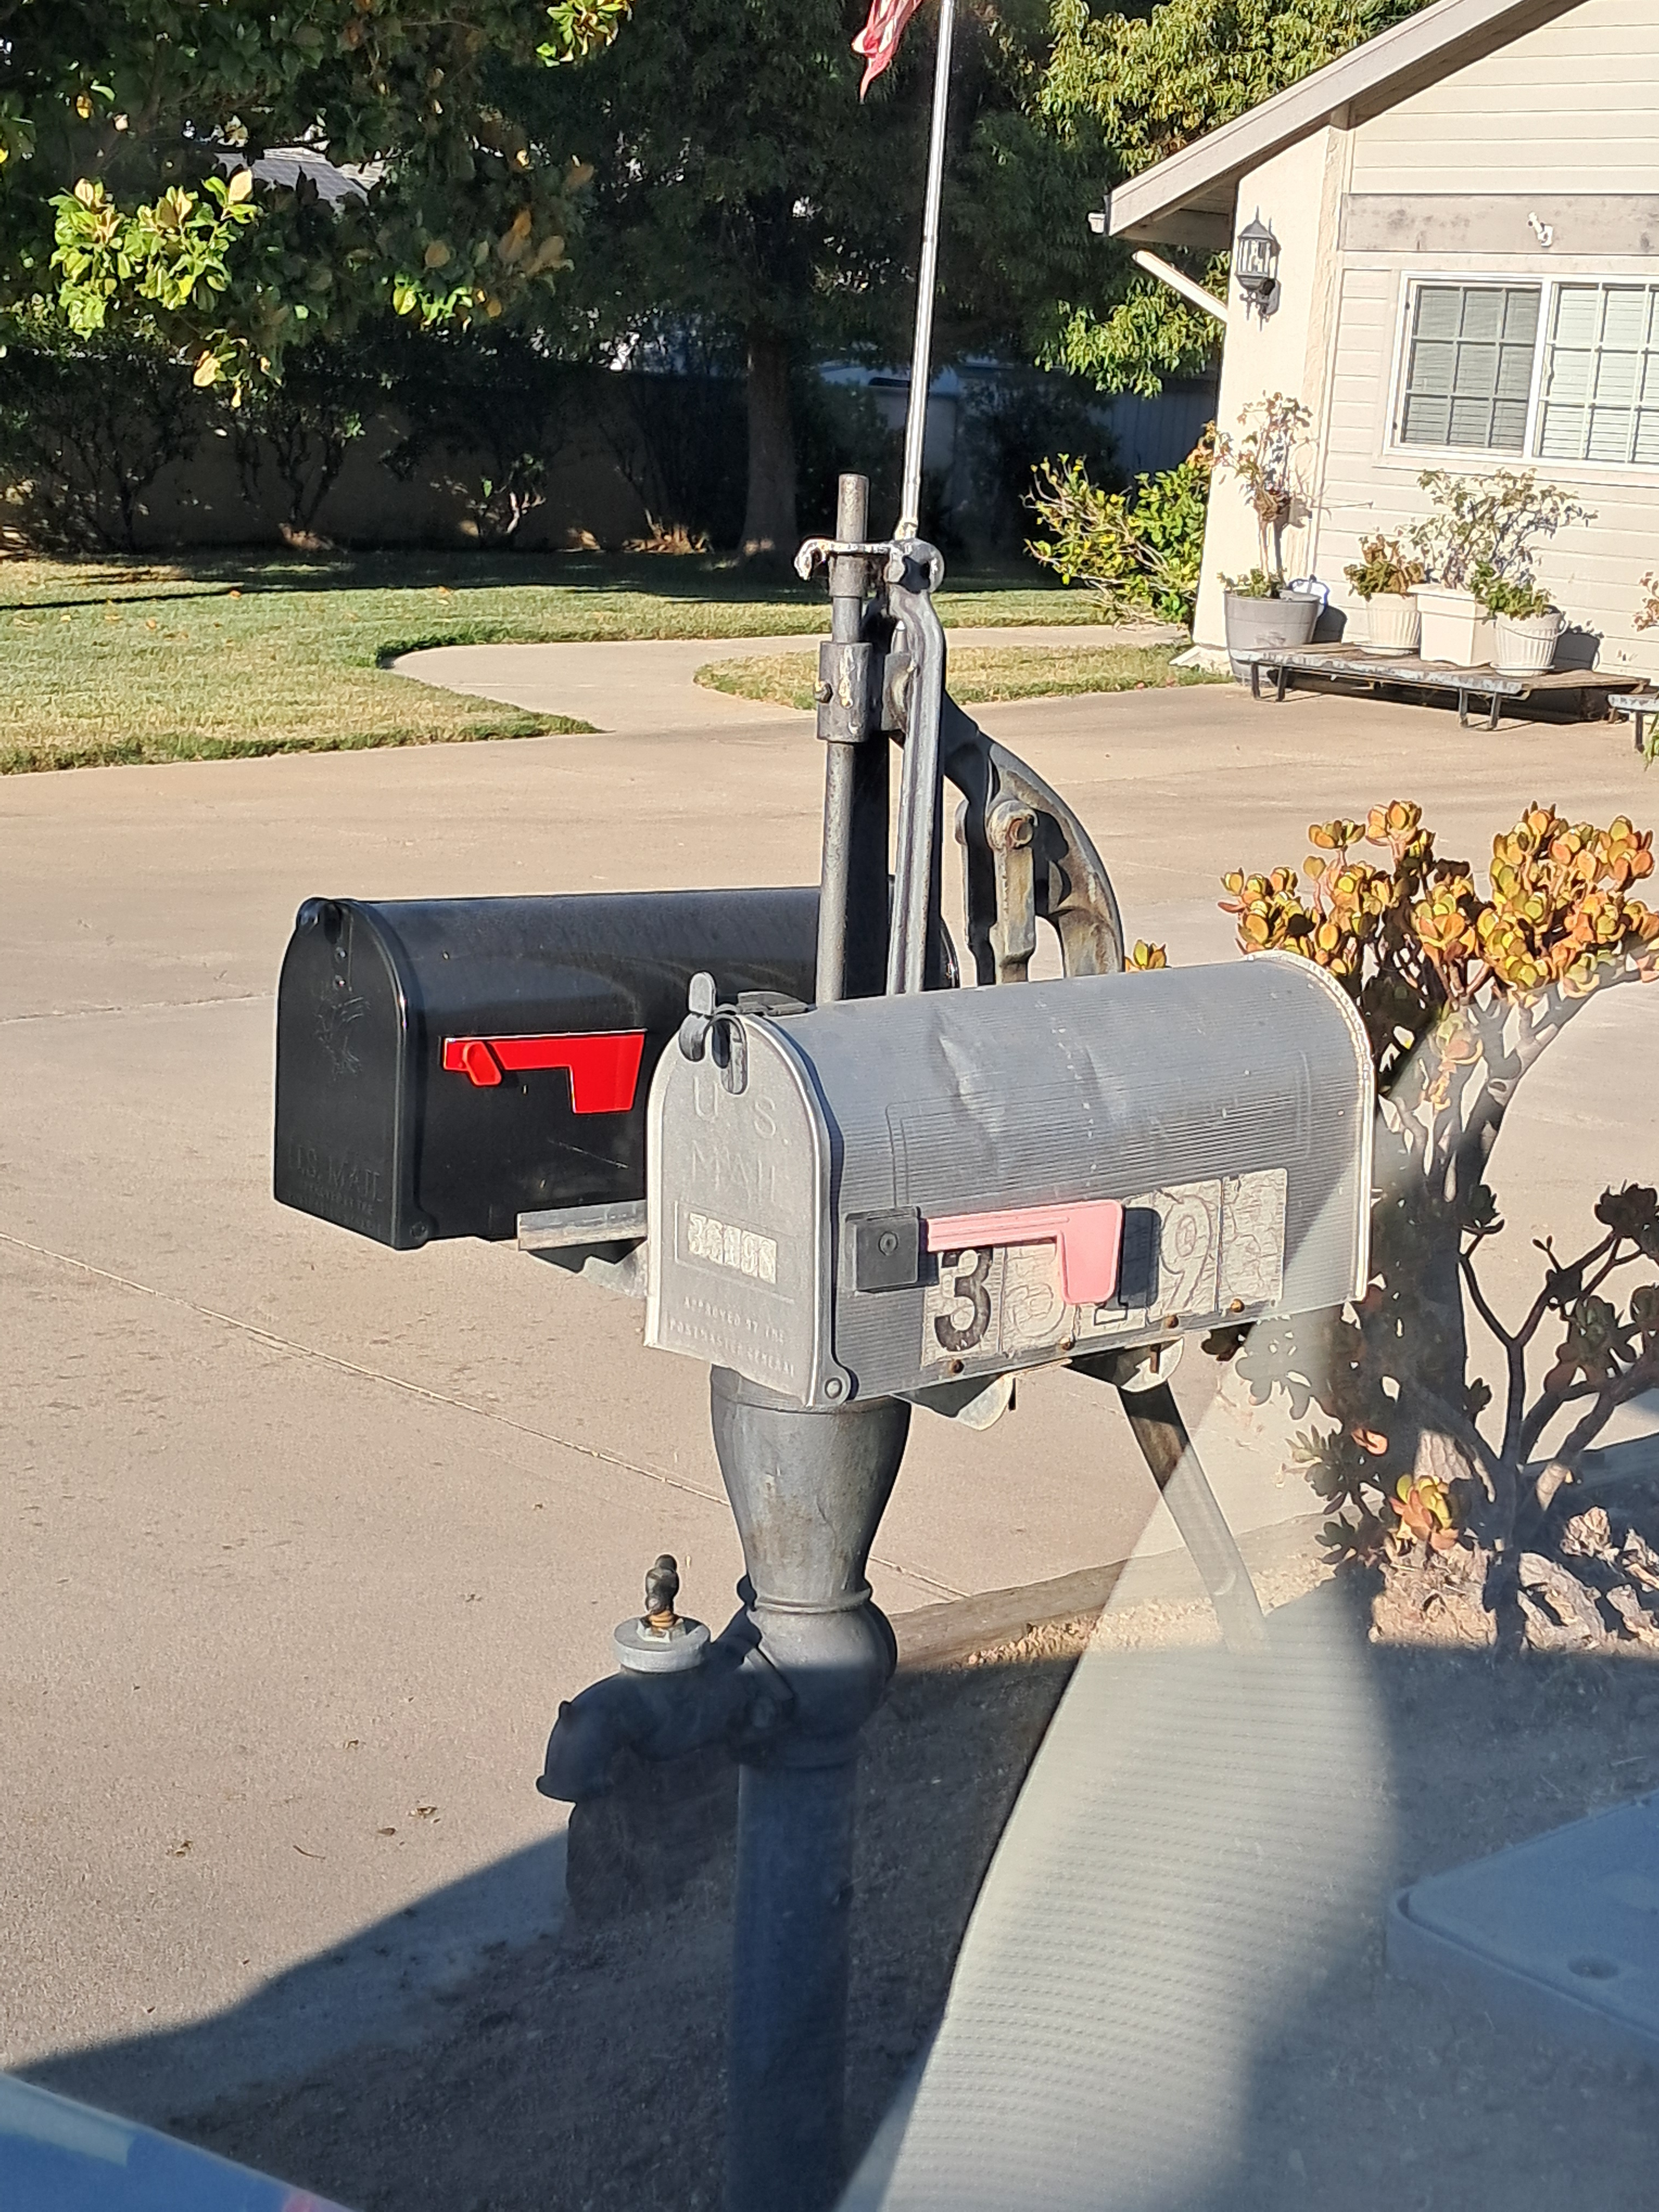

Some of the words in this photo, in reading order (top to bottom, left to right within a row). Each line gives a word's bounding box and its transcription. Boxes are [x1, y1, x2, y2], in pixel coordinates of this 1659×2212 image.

[329, 1155, 383, 1202] MAIL
[684, 1295, 741, 1327] APPROVED
[670, 1316, 743, 1357] POSTMASTER
[747, 1347, 795, 1379] GENERAL
